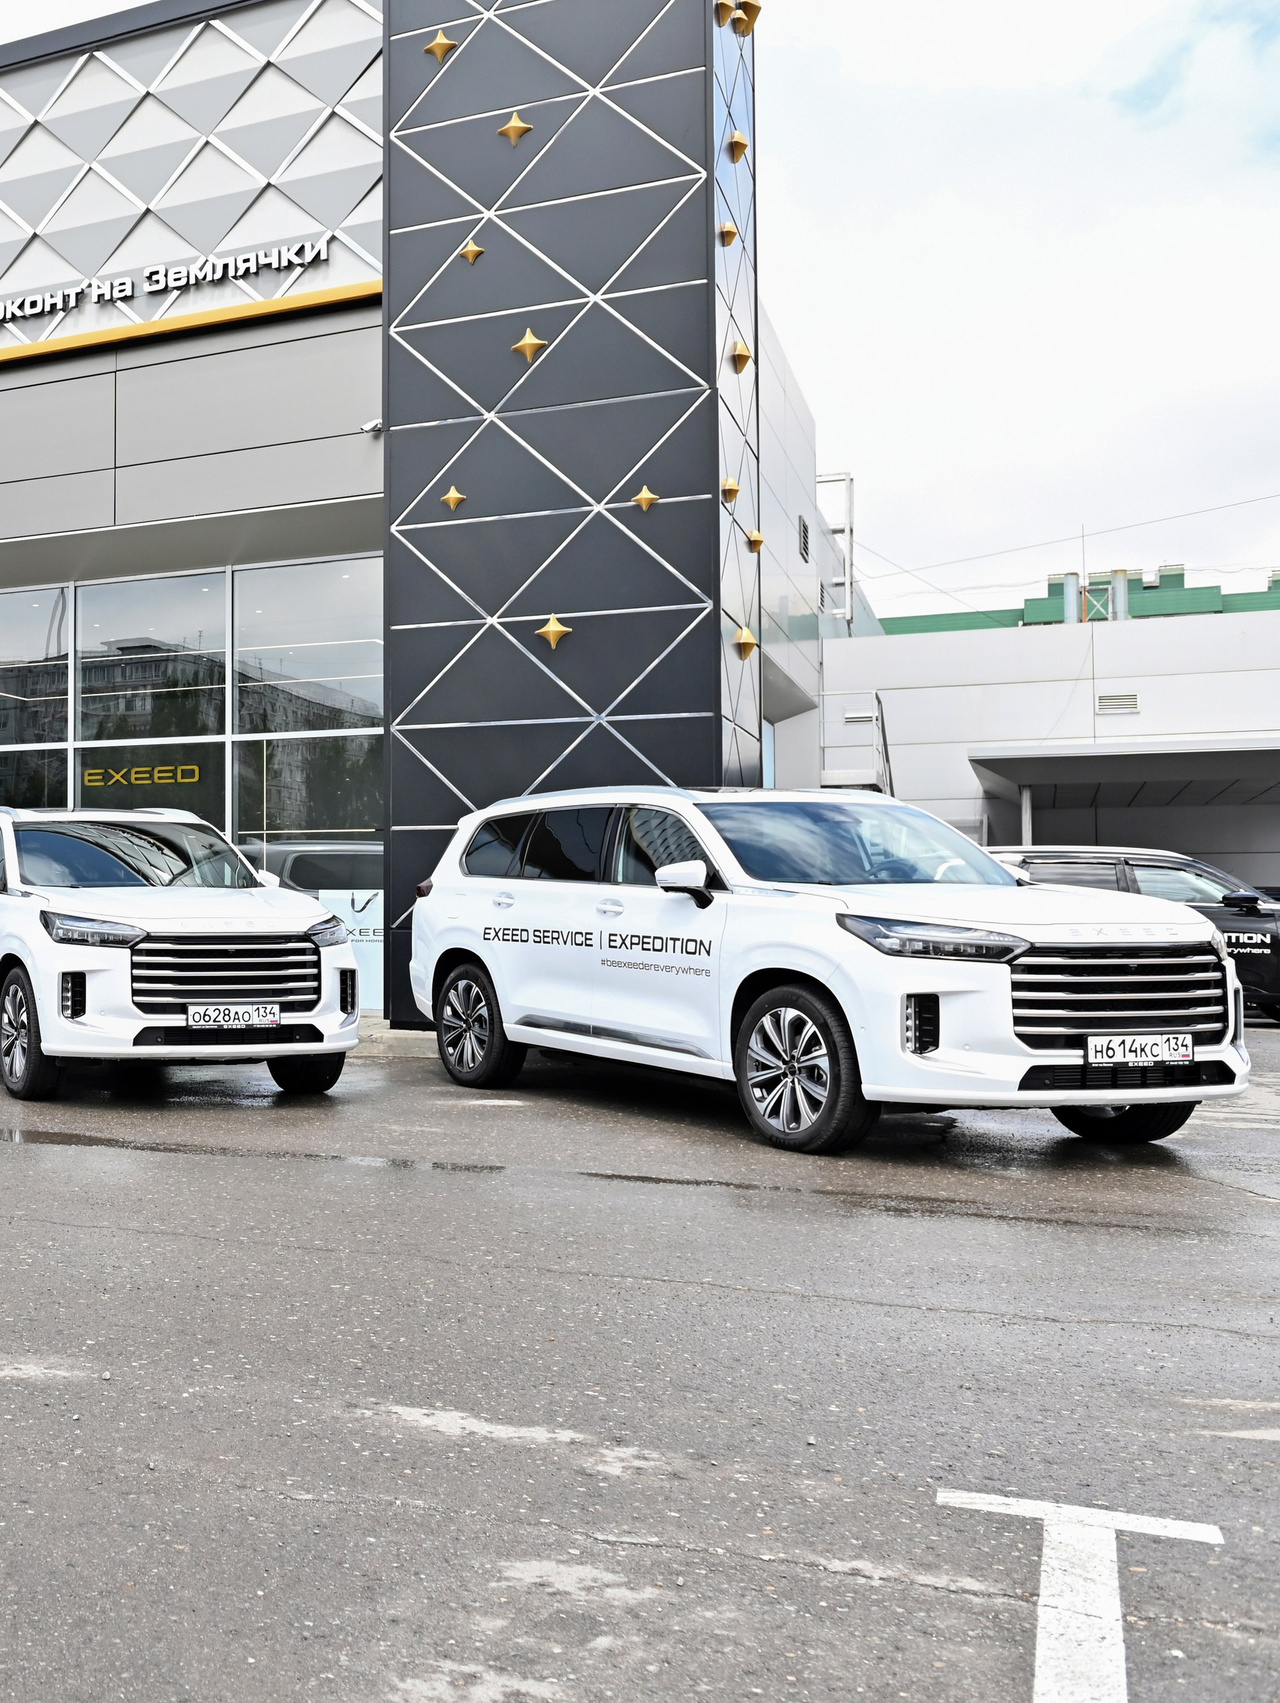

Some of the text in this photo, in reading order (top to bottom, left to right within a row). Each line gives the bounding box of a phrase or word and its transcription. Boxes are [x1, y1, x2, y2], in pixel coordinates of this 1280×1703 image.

[92, 272, 133, 304] на
[142, 237, 330, 294] Землячки
[83, 765, 200, 786] EXEED
[346, 928, 384, 937] XEE
[483, 927, 712, 957] EXEED SERVICE EXPEDITION
[1223, 932, 1271, 944] ITION
[600, 957, 711, 977] #beexeedereverywhere
[192, 1006, 276, 1023] О628АО 134
[1094, 1036, 1190, 1059] Н614КС 134
